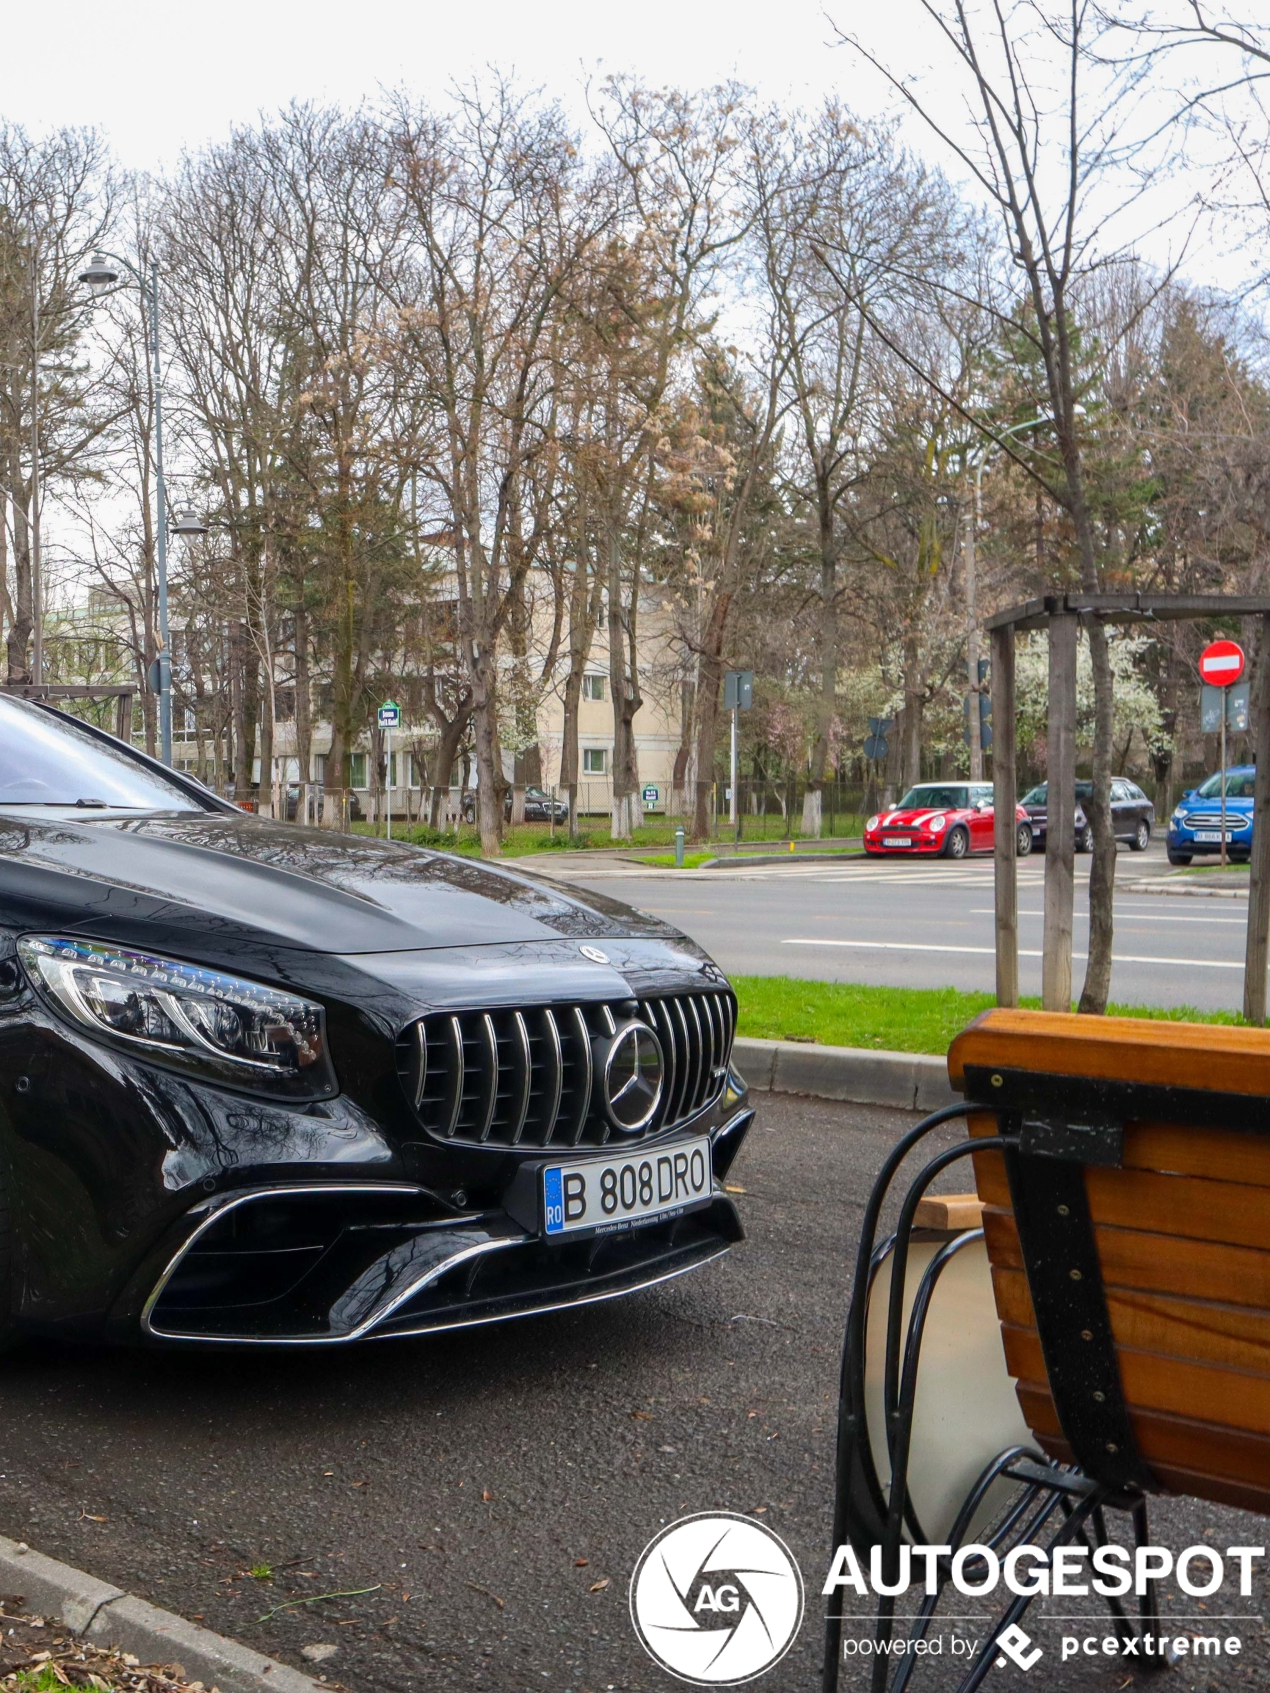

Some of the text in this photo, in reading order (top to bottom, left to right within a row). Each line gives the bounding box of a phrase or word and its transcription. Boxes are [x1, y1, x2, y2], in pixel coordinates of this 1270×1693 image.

[563, 1148, 705, 1222] B 808 DRO
[546, 1204, 562, 1226] RO
[595, 1222, 629, 1234] Mercedes-Benz
